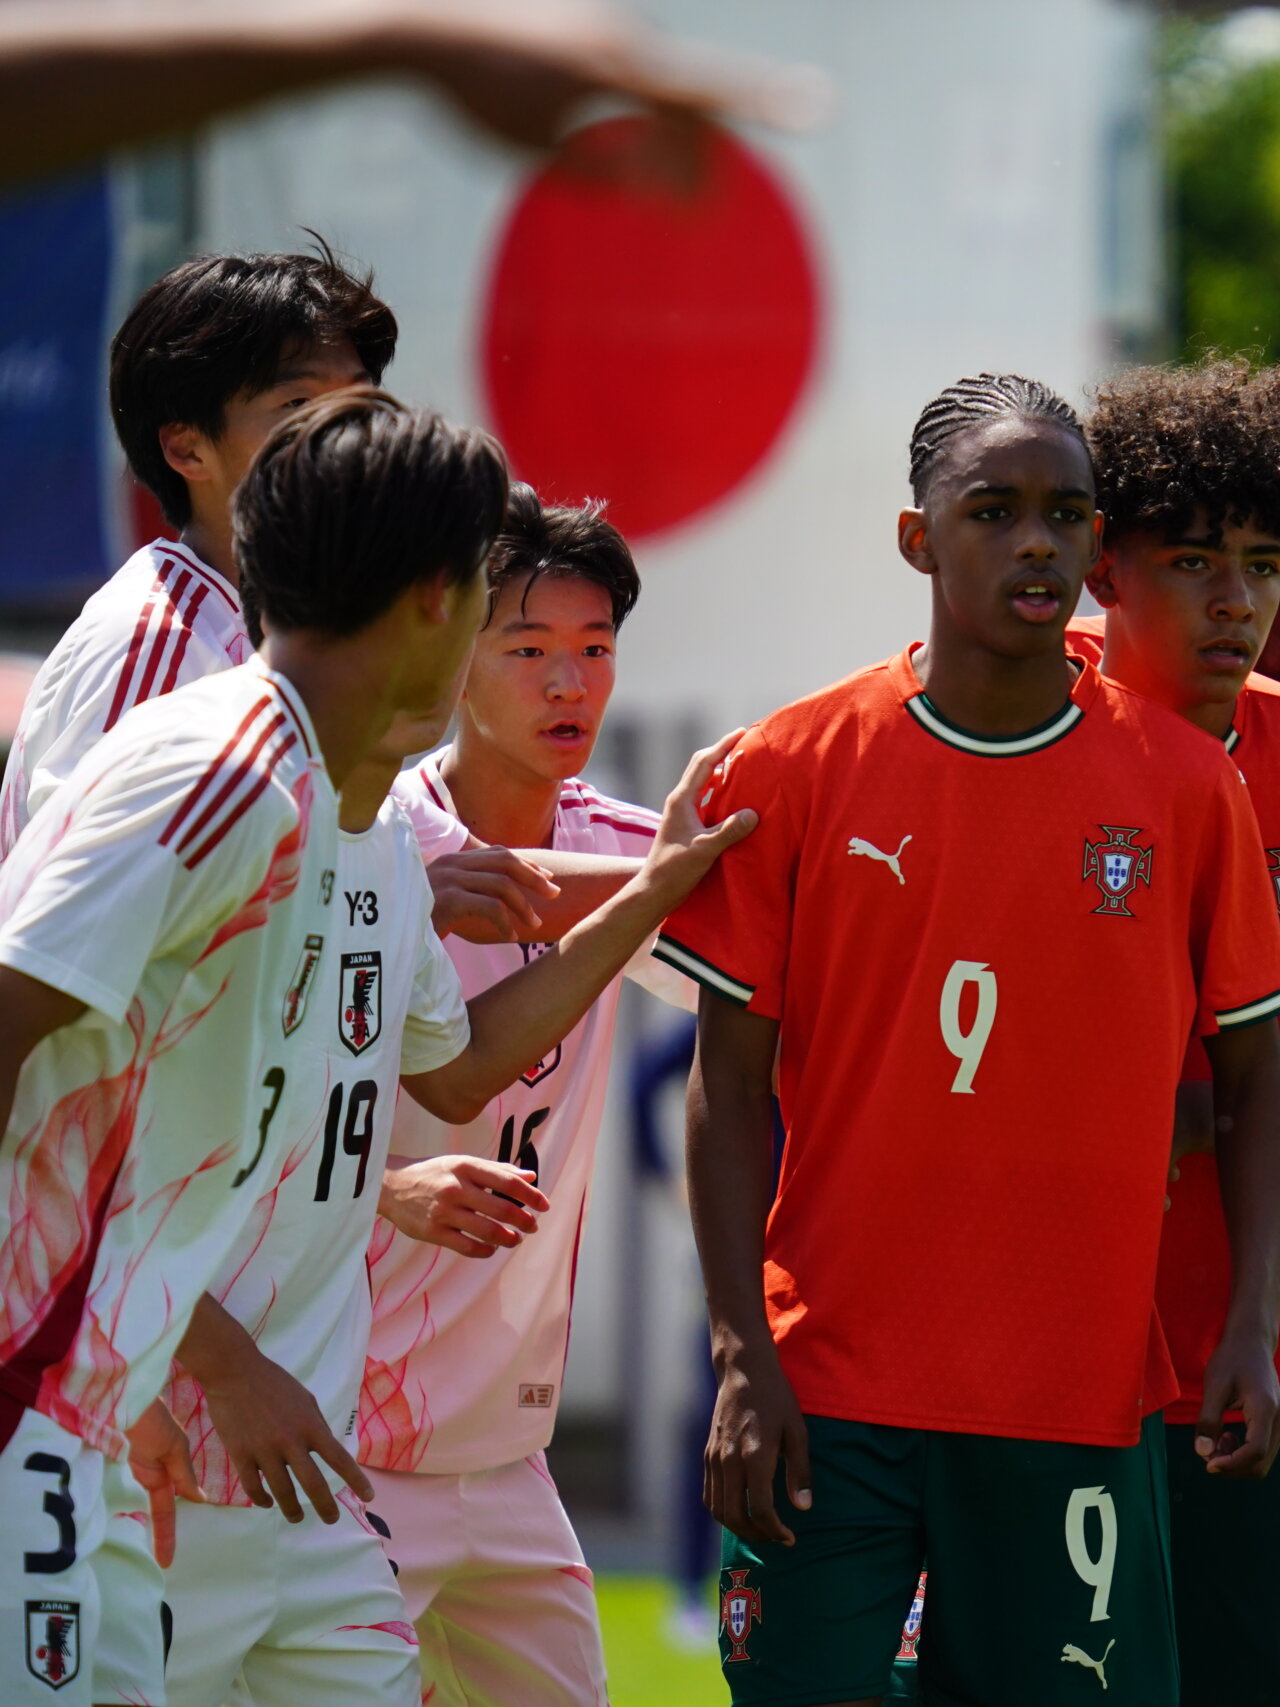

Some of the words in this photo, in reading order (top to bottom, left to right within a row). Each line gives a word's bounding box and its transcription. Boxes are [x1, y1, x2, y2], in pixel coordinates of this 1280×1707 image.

[344, 891, 378, 926] Y-3
[350, 955, 372, 964] JAPAN
[940, 960, 997, 1093] 9
[231, 1067, 285, 1188] 3
[313, 1080, 378, 1201] 19
[23, 1452, 76, 1574] 3
[1065, 1486, 1117, 1622] 9
[40, 1602, 69, 1611] JAPAN
